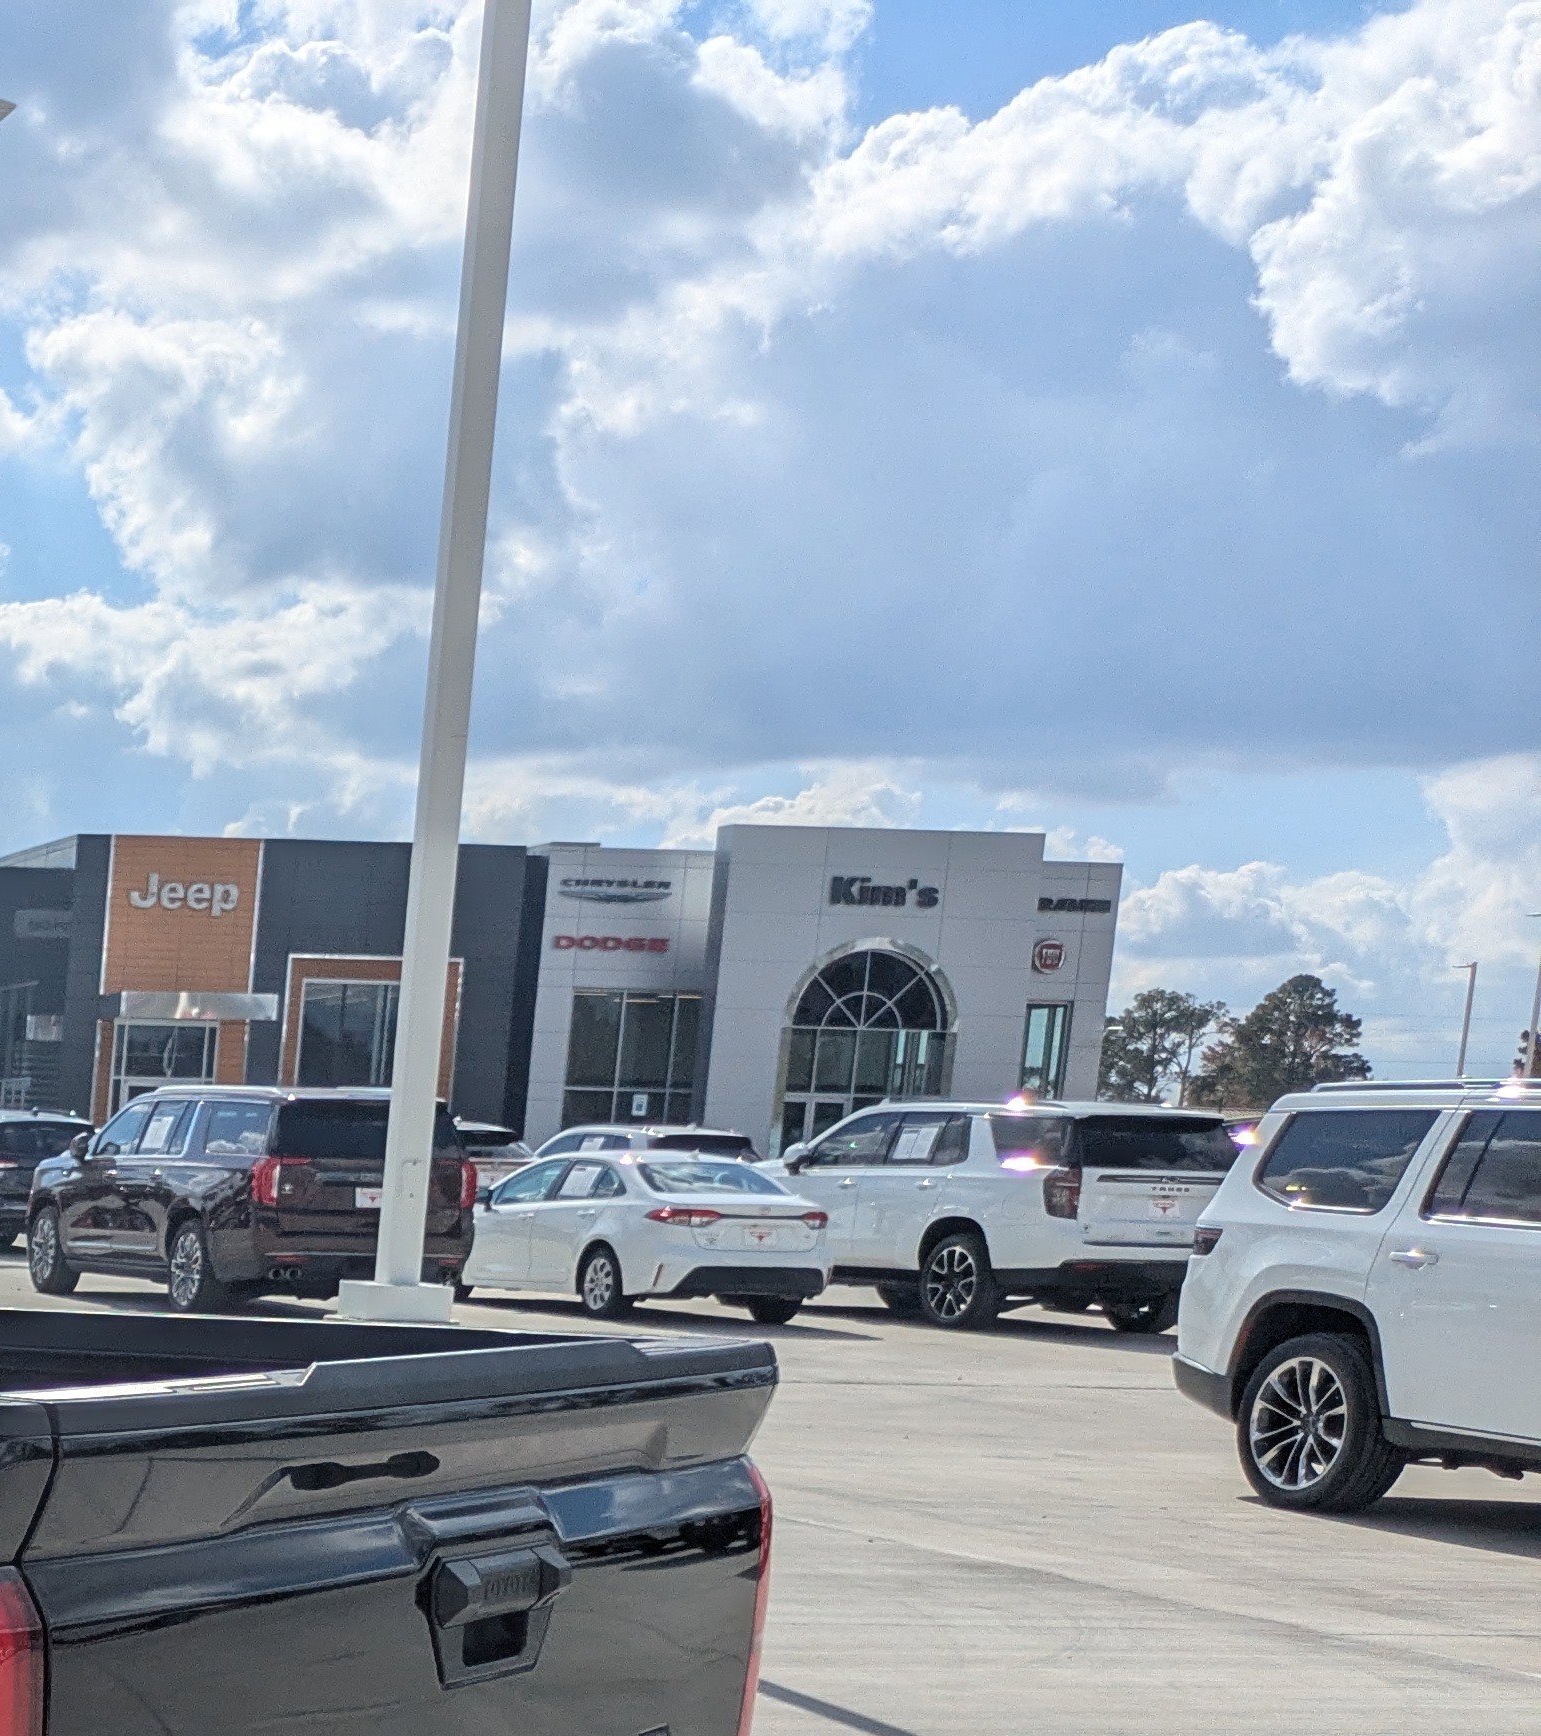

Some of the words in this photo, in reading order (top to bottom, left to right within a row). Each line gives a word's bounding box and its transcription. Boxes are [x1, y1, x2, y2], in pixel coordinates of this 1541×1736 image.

[128, 871, 240, 917] Jeep
[828, 875, 939, 909] Kim's
[553, 934, 670, 954] DODGE
